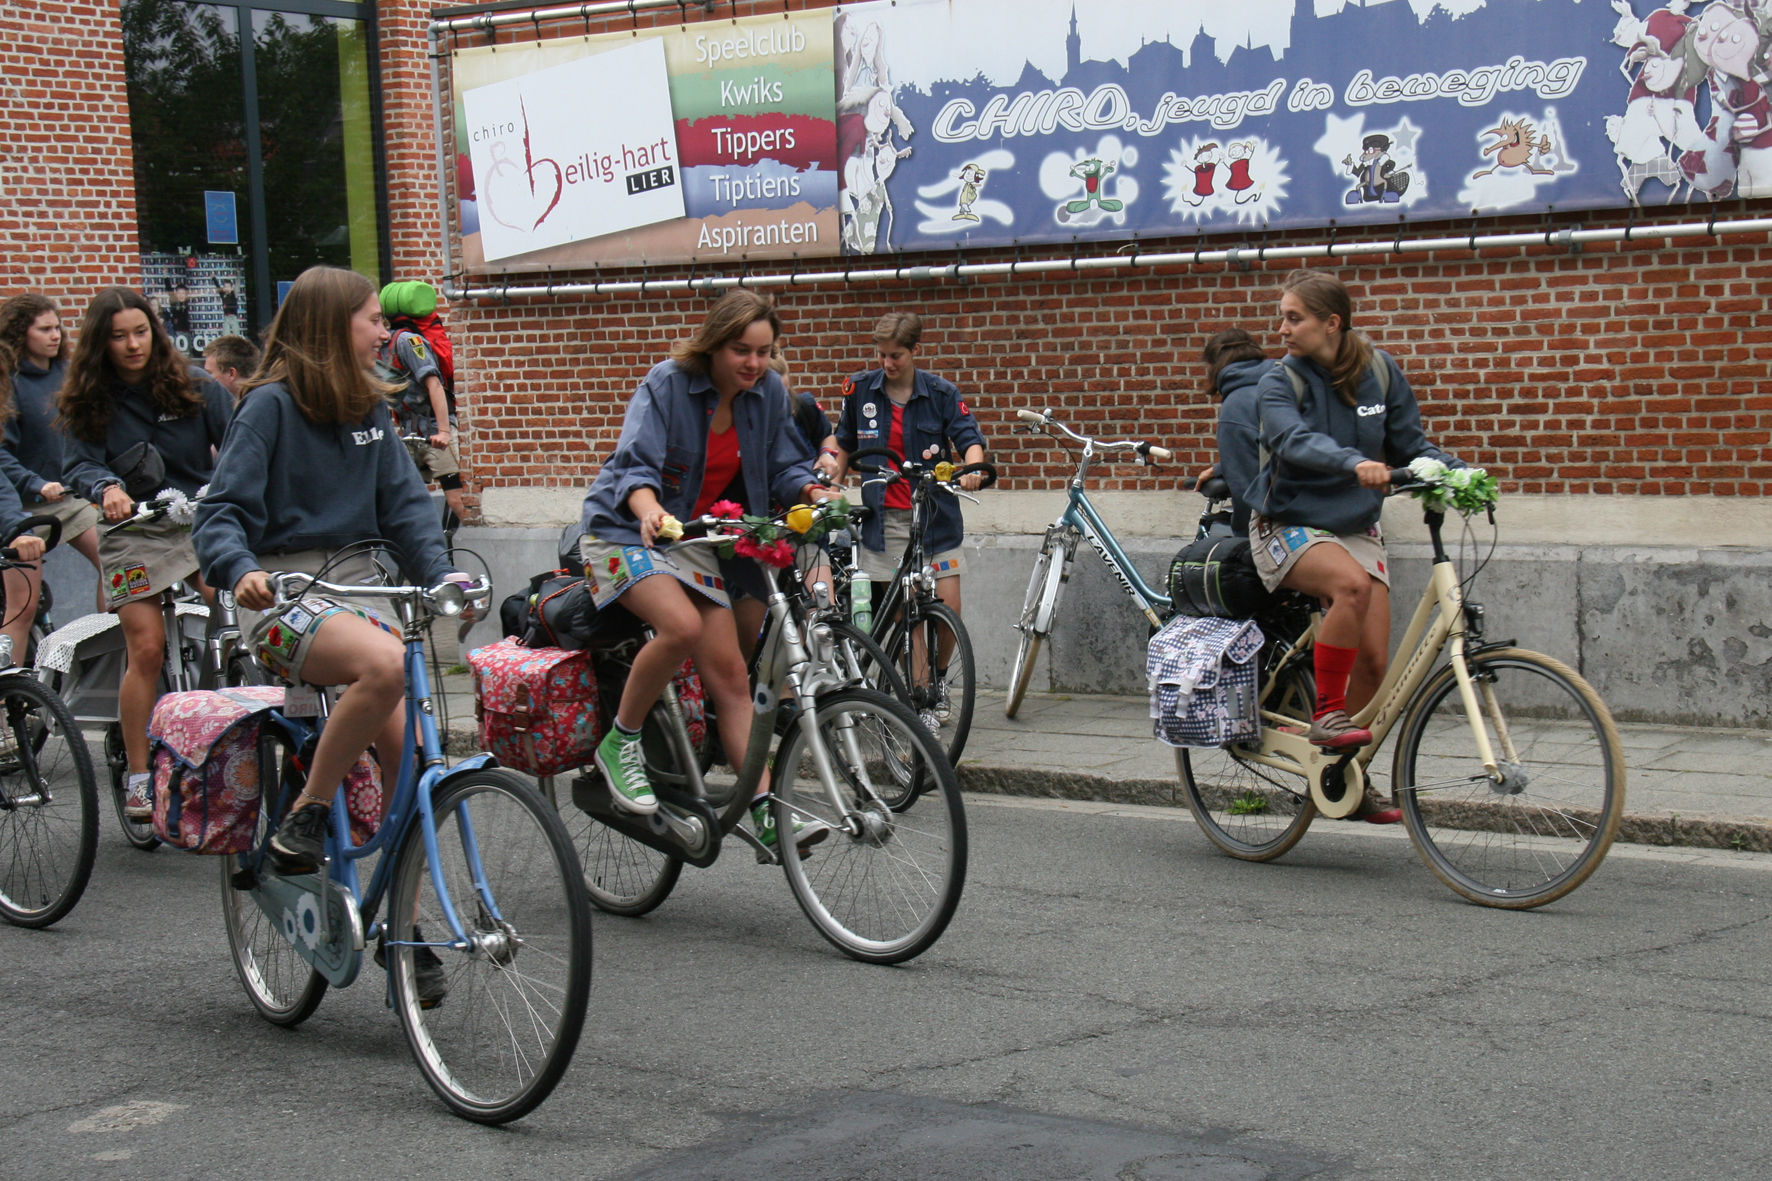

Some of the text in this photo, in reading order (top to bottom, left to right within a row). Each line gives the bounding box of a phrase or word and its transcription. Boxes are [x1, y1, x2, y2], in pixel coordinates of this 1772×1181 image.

[695, 25, 806, 67] Speelclub
[720, 77, 784, 107] Kwiks
[933, 55, 1586, 142] CHIRO, jeugd in beweging
[473, 122, 515, 142] chiro
[711, 127, 796, 160] Tippers
[630, 171, 671, 192] LIER
[709, 173, 801, 206] Tiptiens
[698, 220, 818, 253] Aspiranten
[1087, 535, 1136, 596] L'AVENIR
